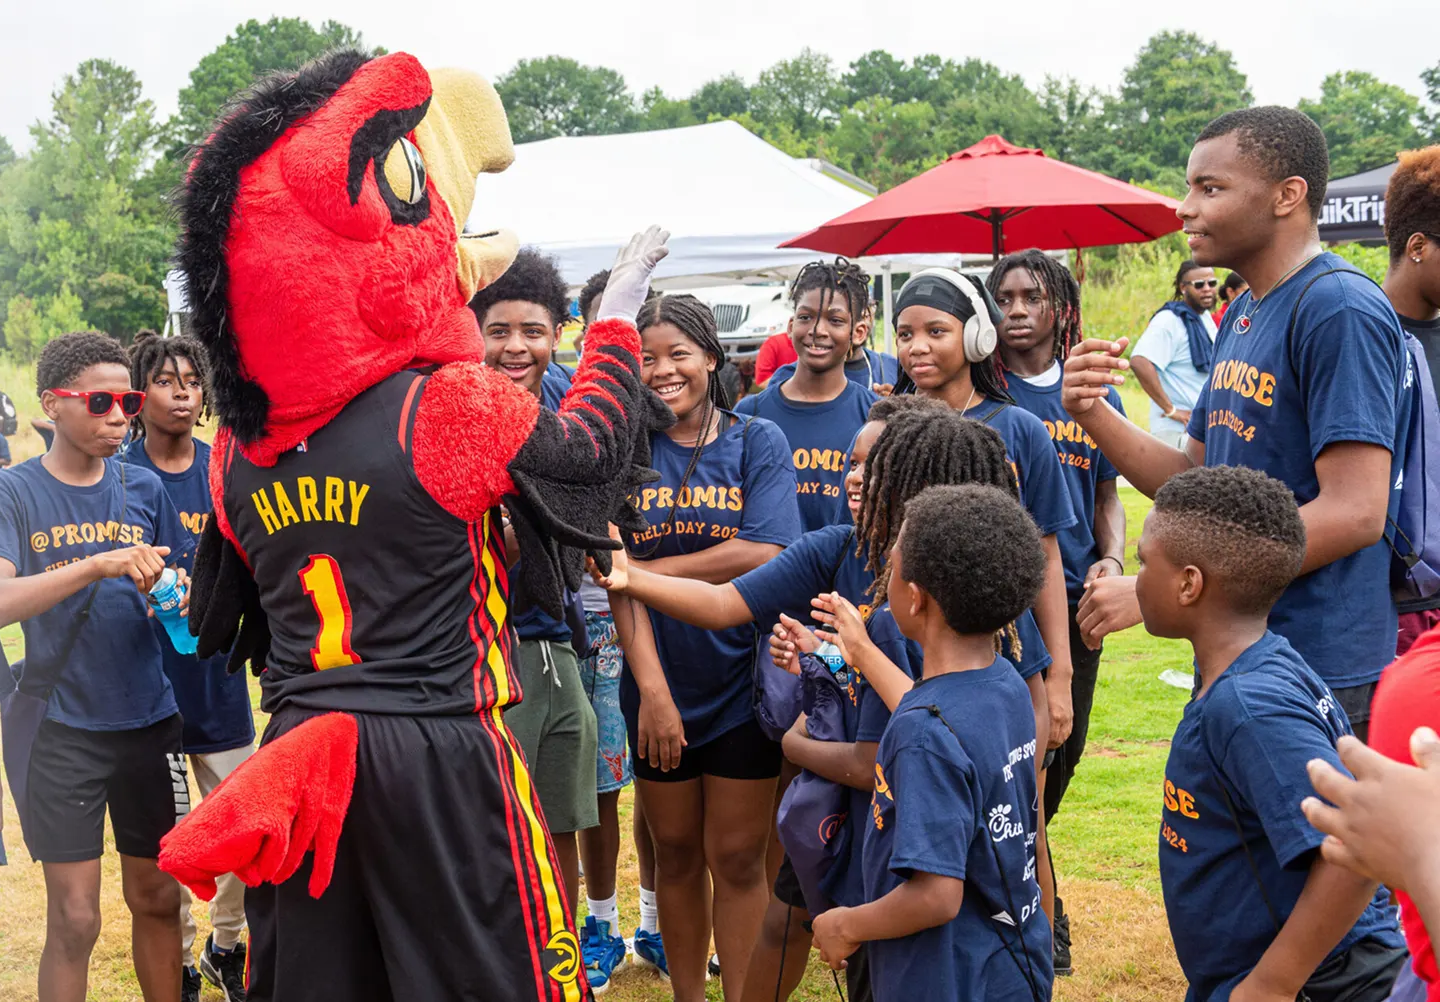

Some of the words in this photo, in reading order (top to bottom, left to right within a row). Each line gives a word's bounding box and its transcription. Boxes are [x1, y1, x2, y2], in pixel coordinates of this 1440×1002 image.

[251, 476, 370, 535] HARRY
[823, 484, 840, 497] 20
[675, 521, 706, 534] DAY
[298, 553, 363, 672] 1
